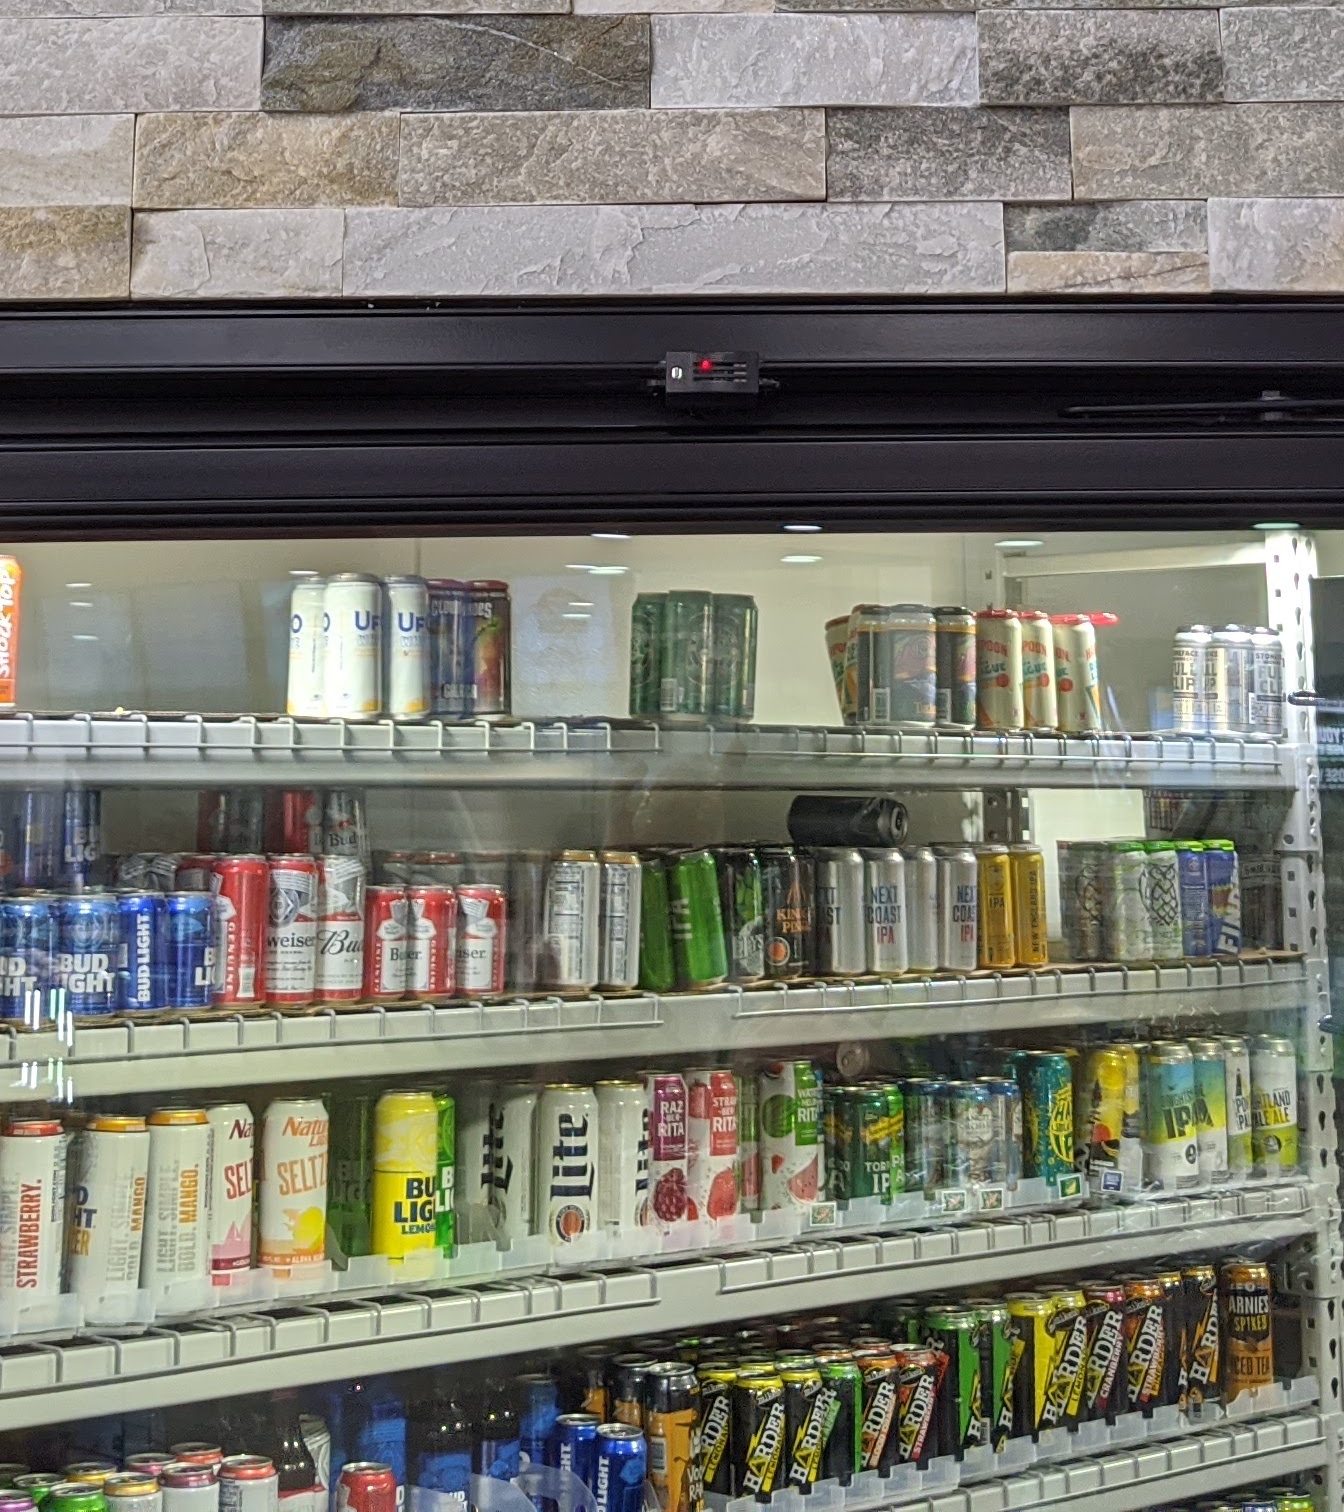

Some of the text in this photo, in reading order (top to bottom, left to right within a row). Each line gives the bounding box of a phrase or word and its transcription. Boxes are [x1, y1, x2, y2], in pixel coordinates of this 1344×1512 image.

[355, 610, 381, 631] UF
[398, 612, 426, 633] UF
[64, 842, 102, 863] LIG
[870, 885, 899, 905] NEXT
[989, 895, 1006, 910] IPA
[670, 898, 693, 940] IPA
[867, 904, 902, 925] COAST
[267, 929, 314, 949] weiser
[877, 926, 895, 945] IPA
[136, 913, 151, 1002] BUD LIGHT
[660, 1100, 684, 1113] RAZ
[1273, 1106, 1290, 1124] ALE
[657, 1121, 685, 1138] RITA
[550, 1112, 595, 1202] Lite
[276, 1151, 328, 1196] SELTZ
[179, 1163, 200, 1224] MANGO.
[406, 1177, 436, 1200] BU
[393, 1200, 436, 1224] LIG
[16, 1178, 43, 1289] STRAWBERRY.
[1041, 1315, 1088, 1424] HARDER
[743, 1402, 785, 1492] HARDER
